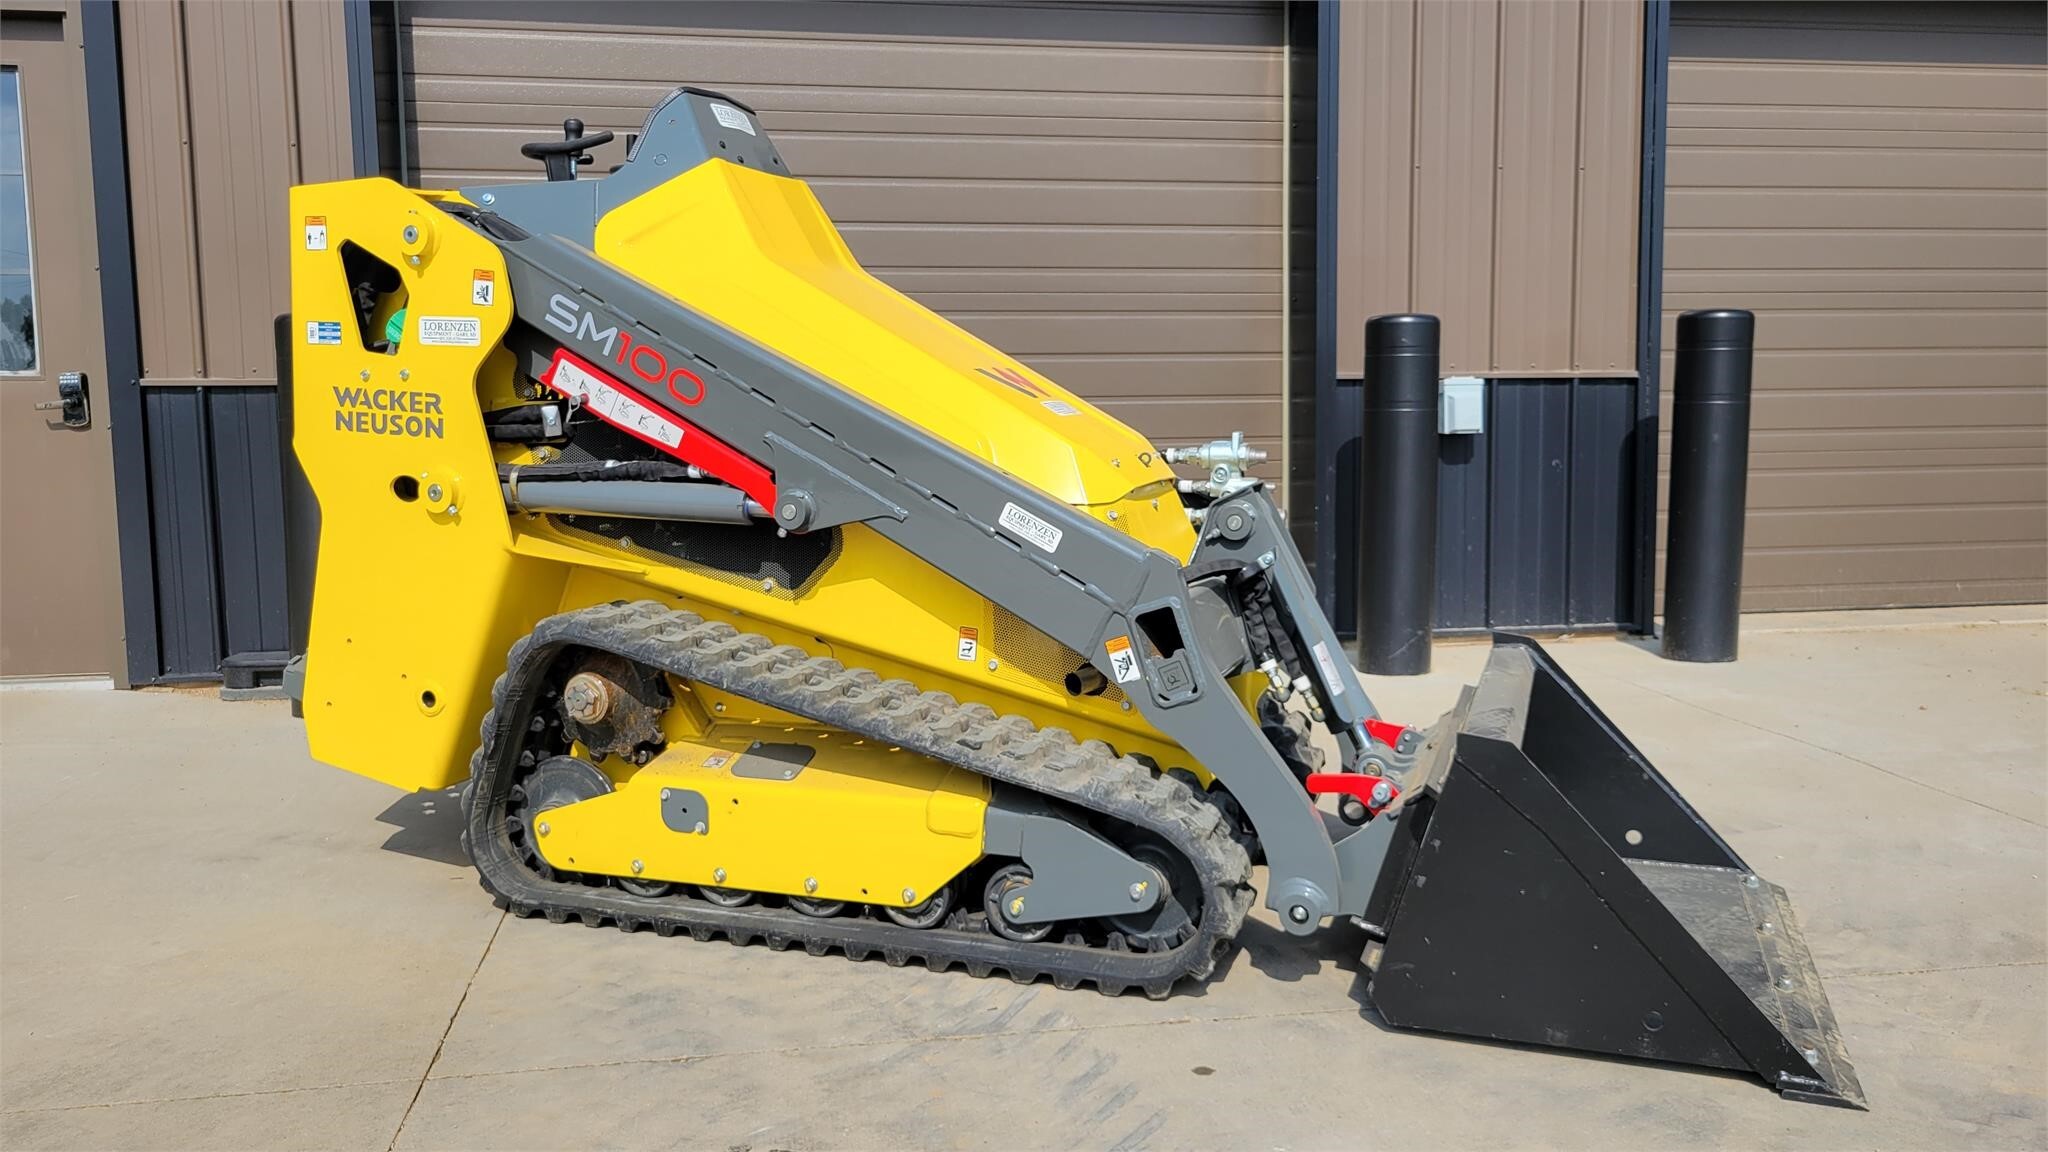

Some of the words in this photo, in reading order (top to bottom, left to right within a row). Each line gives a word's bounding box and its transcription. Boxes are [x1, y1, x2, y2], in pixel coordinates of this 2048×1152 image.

[424, 321, 477, 332] LORENZEN
[544, 293, 706, 406] SM100
[332, 386, 443, 415] WACKER
[335, 410, 444, 439] NEUSON
[1007, 508, 1058, 540] LORENZEN
